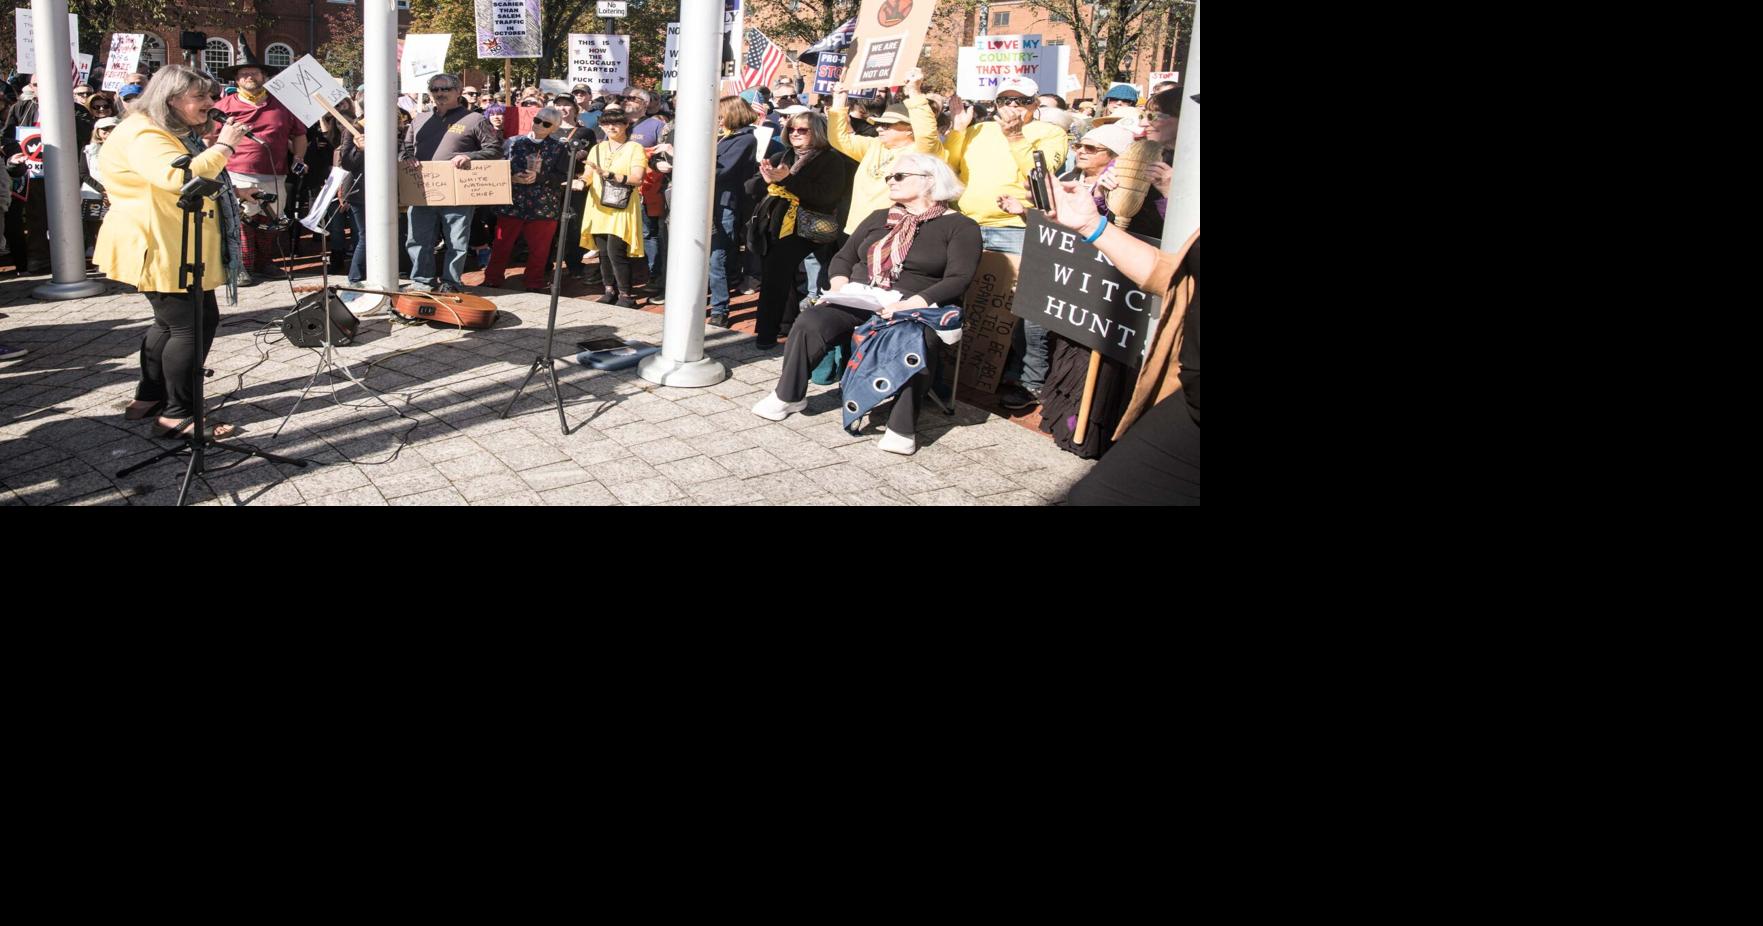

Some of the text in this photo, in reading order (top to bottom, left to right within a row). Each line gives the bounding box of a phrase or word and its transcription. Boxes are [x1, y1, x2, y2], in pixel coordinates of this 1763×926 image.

[871, 41, 899, 52] WE ARE
[977, 41, 984, 50] I
[1022, 39, 1040, 49] MY
[820, 54, 847, 63] PRO-A
[818, 64, 842, 78] STO
[862, 68, 890, 79] NOT OK
[976, 64, 1040, 74] THAT'S WHY
[1038, 224, 1077, 254] WE
[1053, 263, 1152, 316] WITC
[992, 293, 1006, 309] TO
[977, 314, 999, 340] TELL
[996, 320, 1014, 336] TO
[989, 340, 1006, 359] BE
